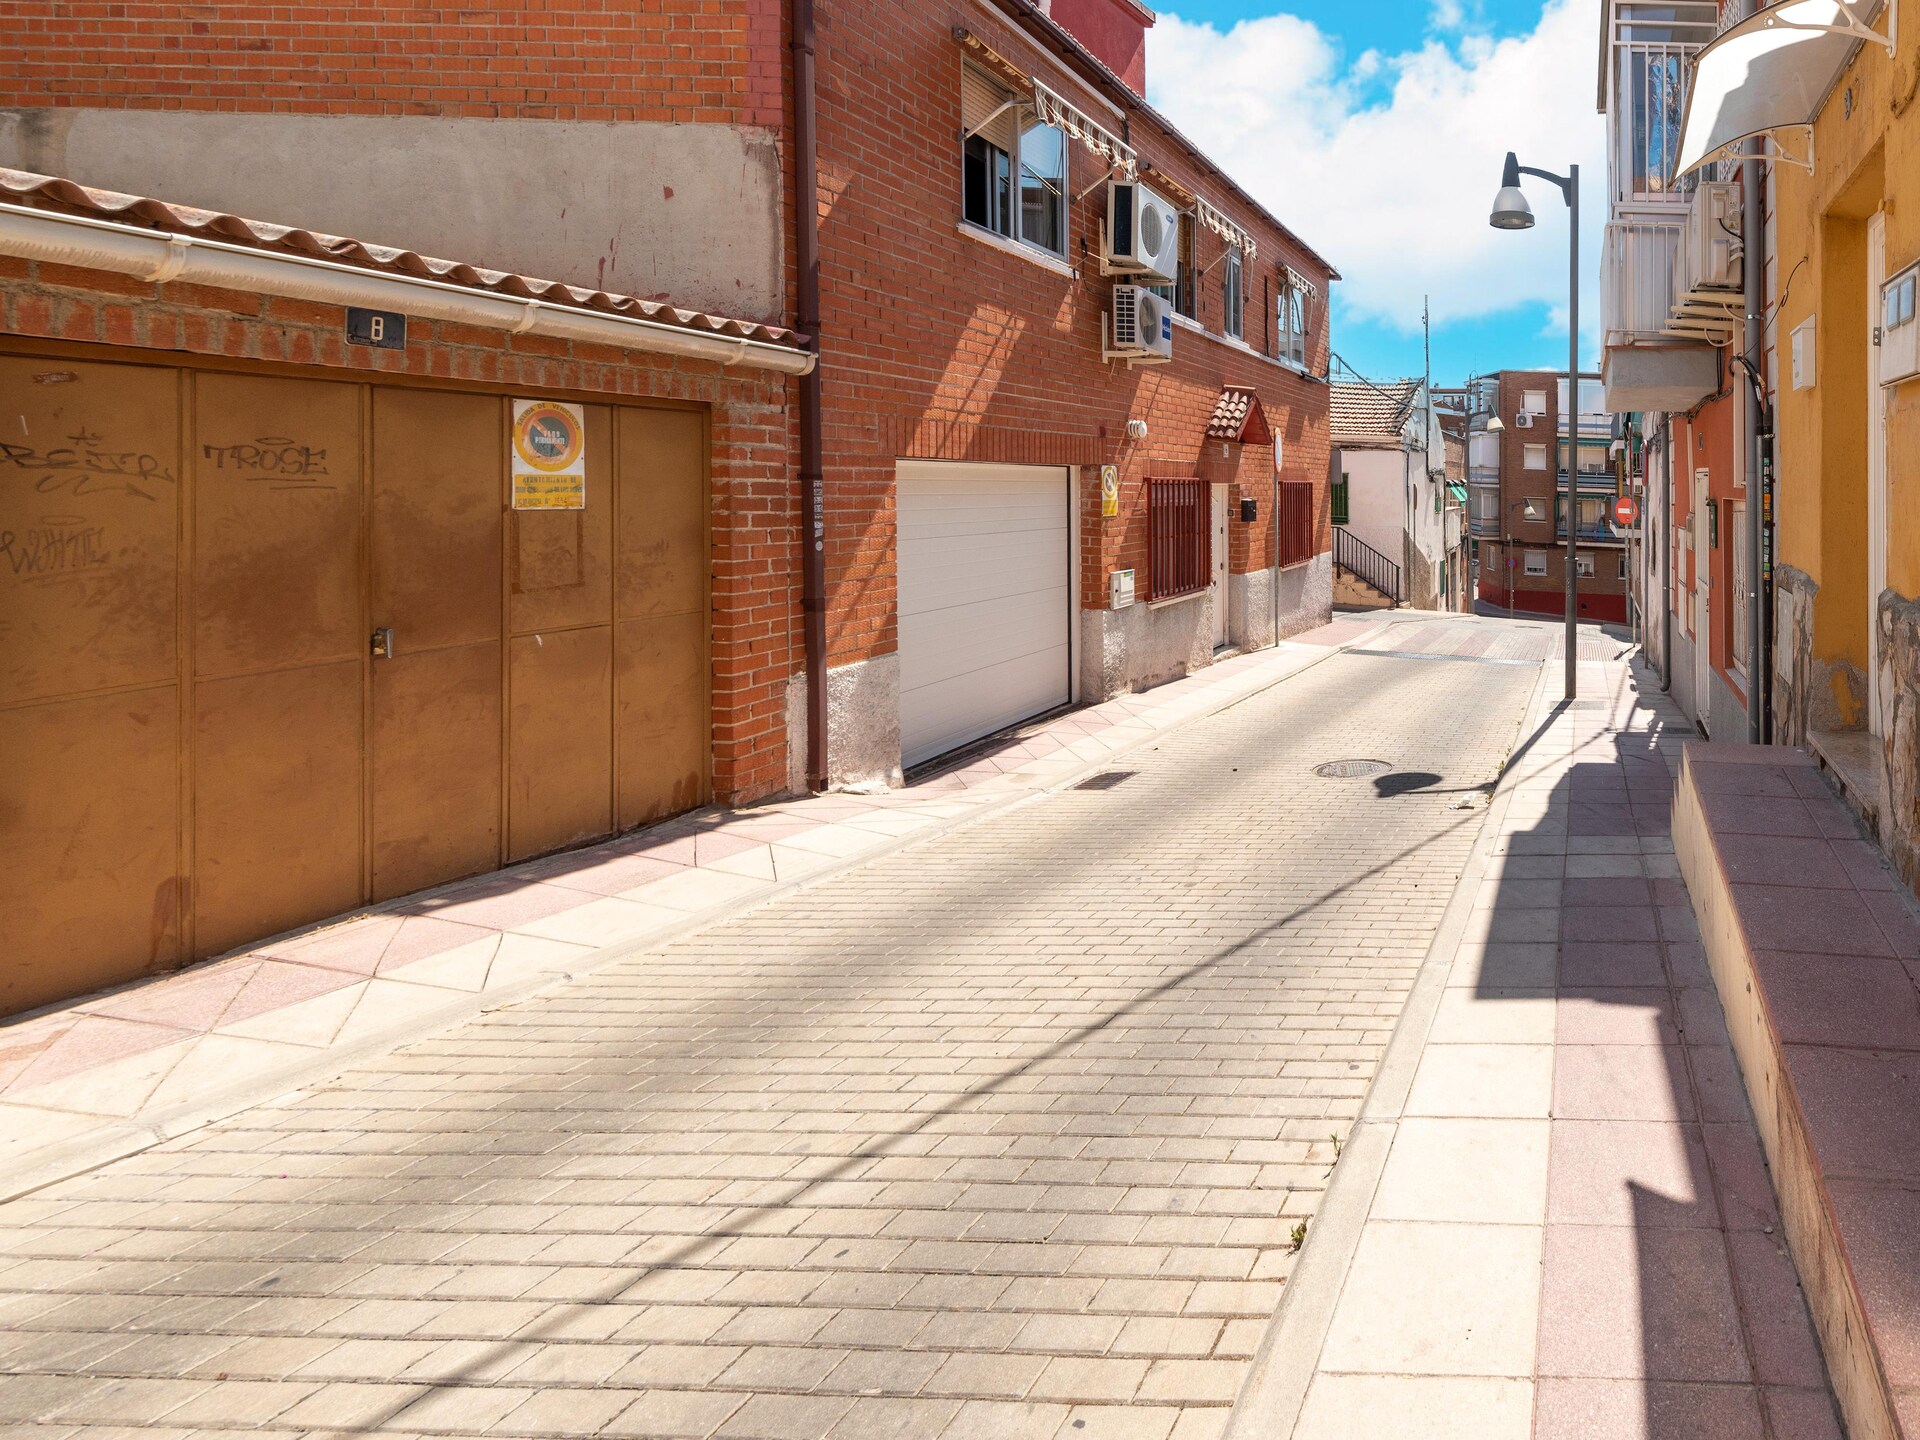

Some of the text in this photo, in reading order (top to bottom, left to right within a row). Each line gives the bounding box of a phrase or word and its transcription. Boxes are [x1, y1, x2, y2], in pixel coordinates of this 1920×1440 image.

[371, 316, 384, 341] 8
[517, 407, 535, 427] SALIDA
[552, 403, 581, 431] VEHICULOS
